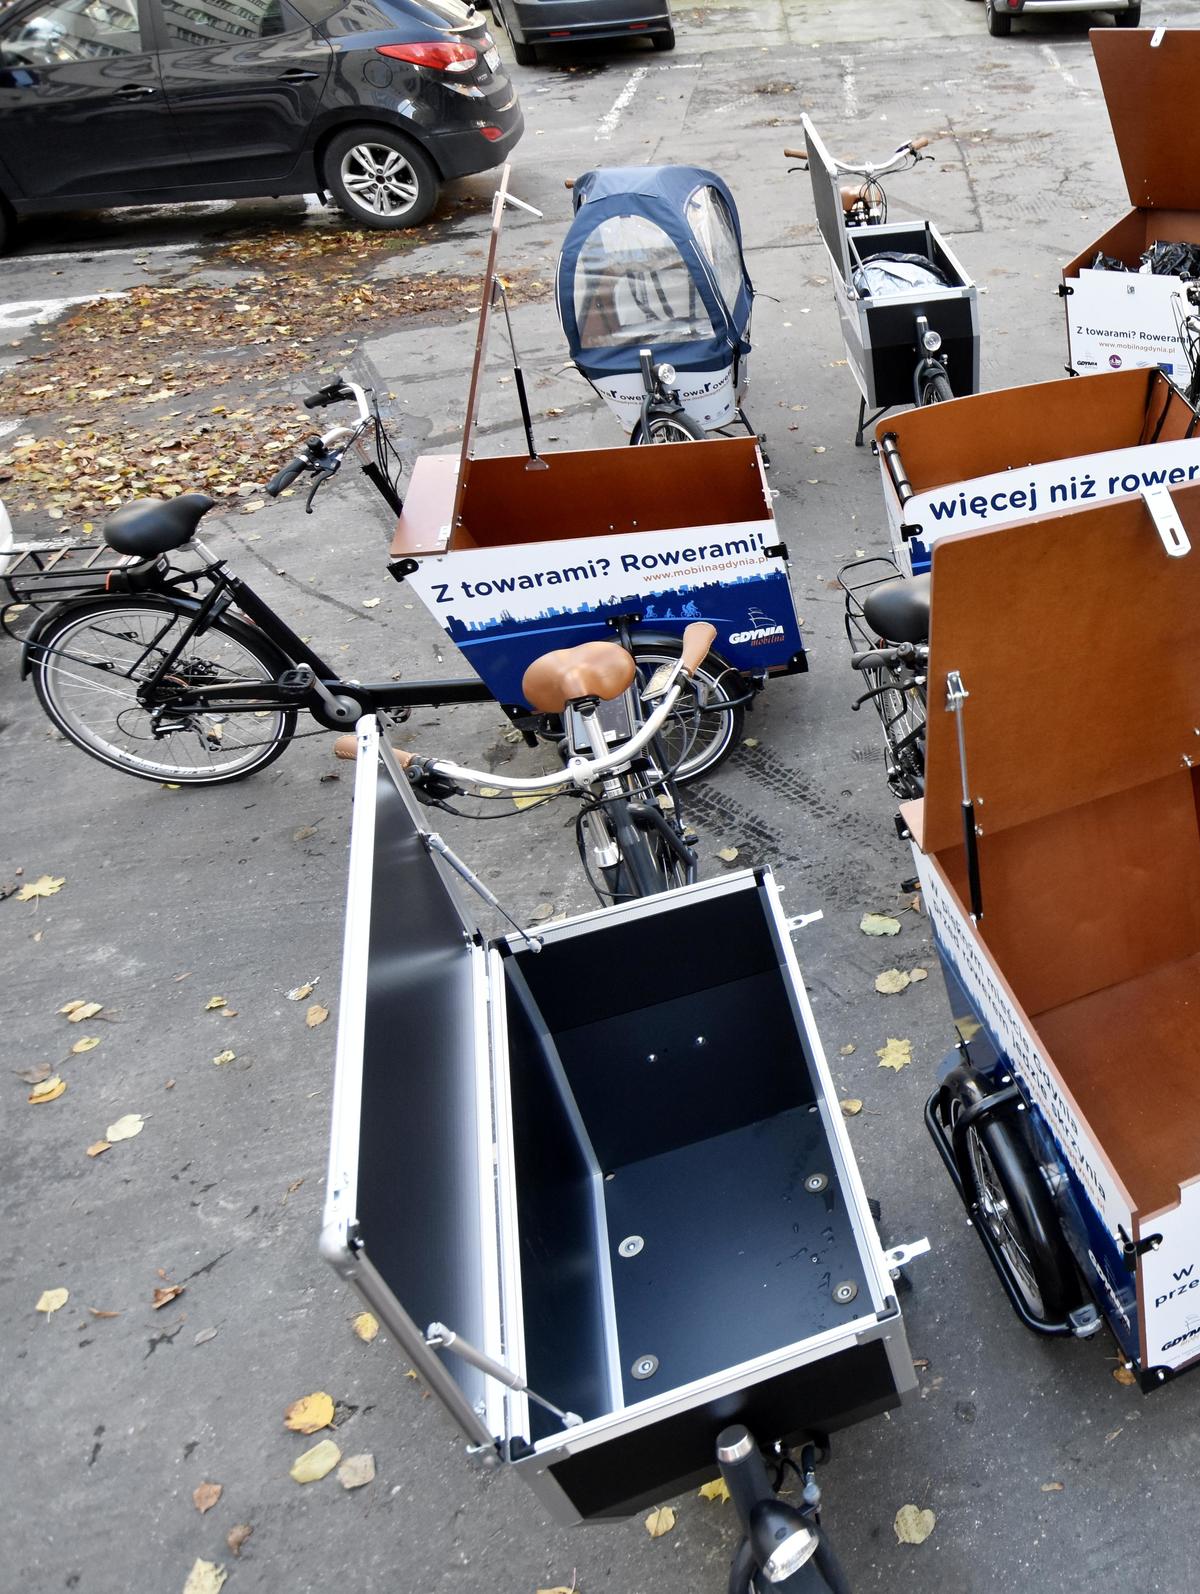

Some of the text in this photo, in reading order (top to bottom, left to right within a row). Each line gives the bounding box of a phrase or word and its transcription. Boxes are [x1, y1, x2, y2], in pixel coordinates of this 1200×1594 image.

[1086, 327, 1136, 339] towarami?
[1099, 341, 1176, 353] www.mobilnagdynia.pl
[929, 464, 1200, 519] więcej niż rower
[431, 533, 766, 603] Z towarami? Rowerami!
[729, 625, 785, 645] GDYNIA
[1172, 1264, 1194, 1281] W
